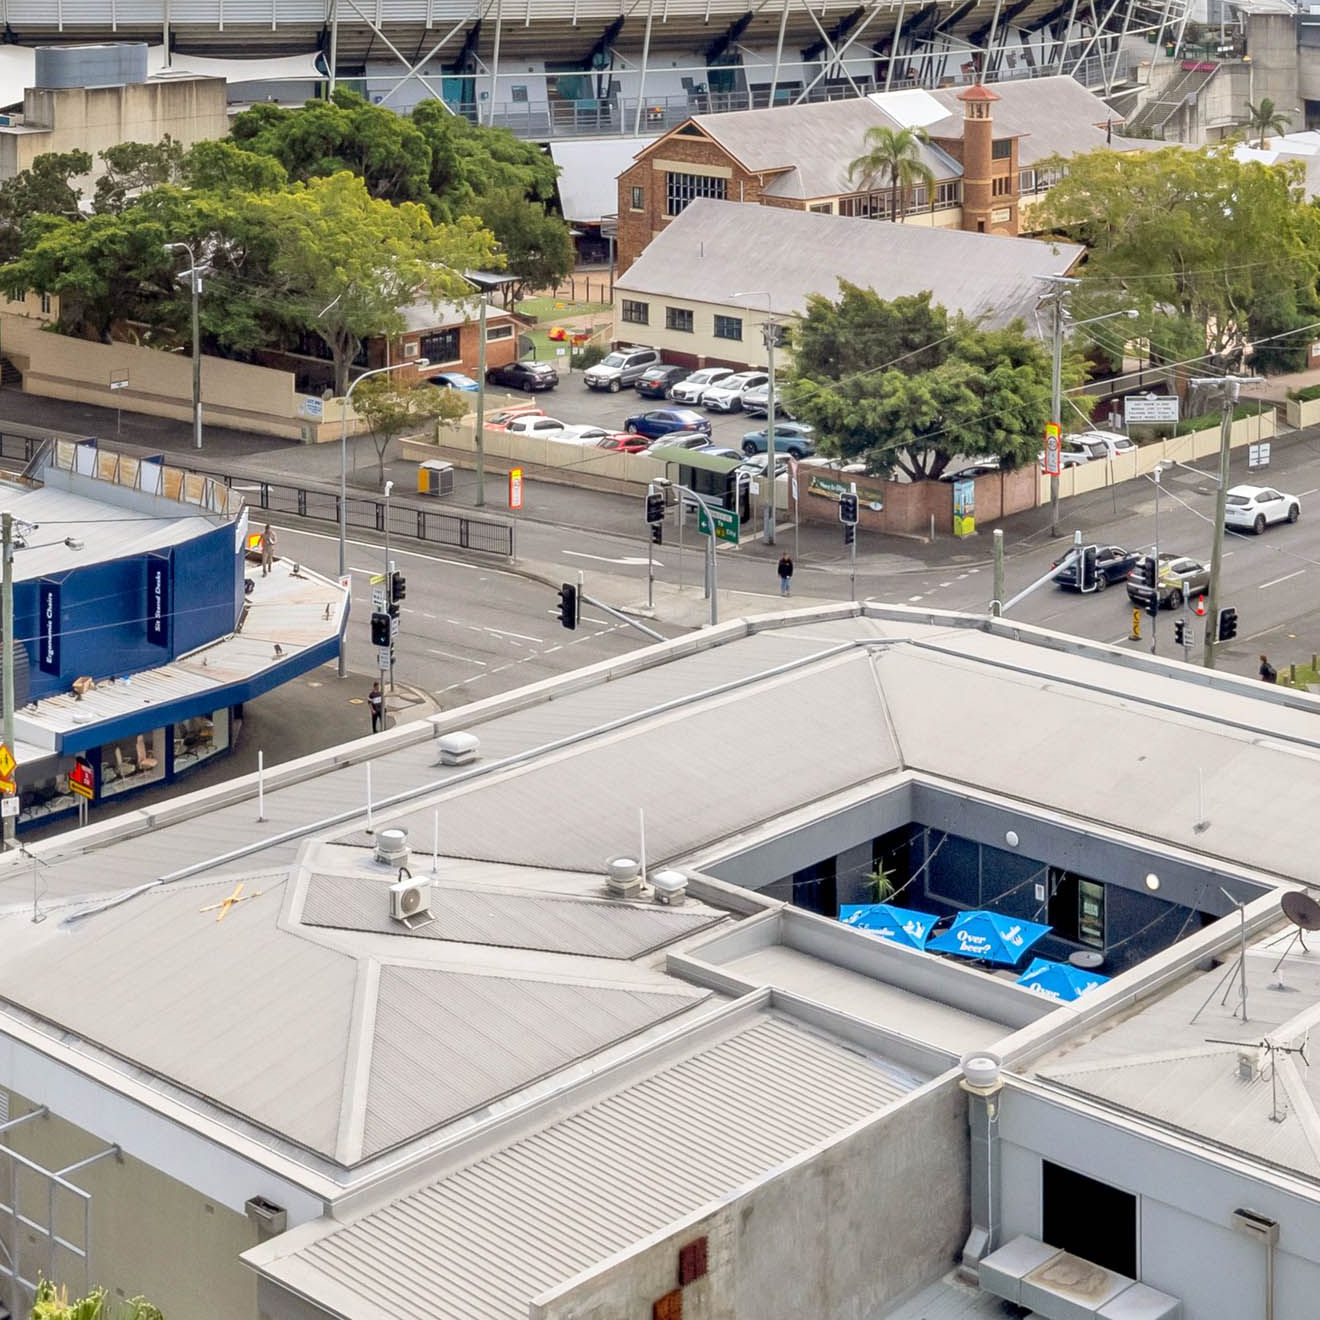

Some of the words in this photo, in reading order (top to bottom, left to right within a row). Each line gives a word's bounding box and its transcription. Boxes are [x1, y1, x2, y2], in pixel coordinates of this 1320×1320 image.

[956, 929, 987, 945] Over
[959, 939, 992, 955] beer?
[1030, 982, 1060, 999] Over
